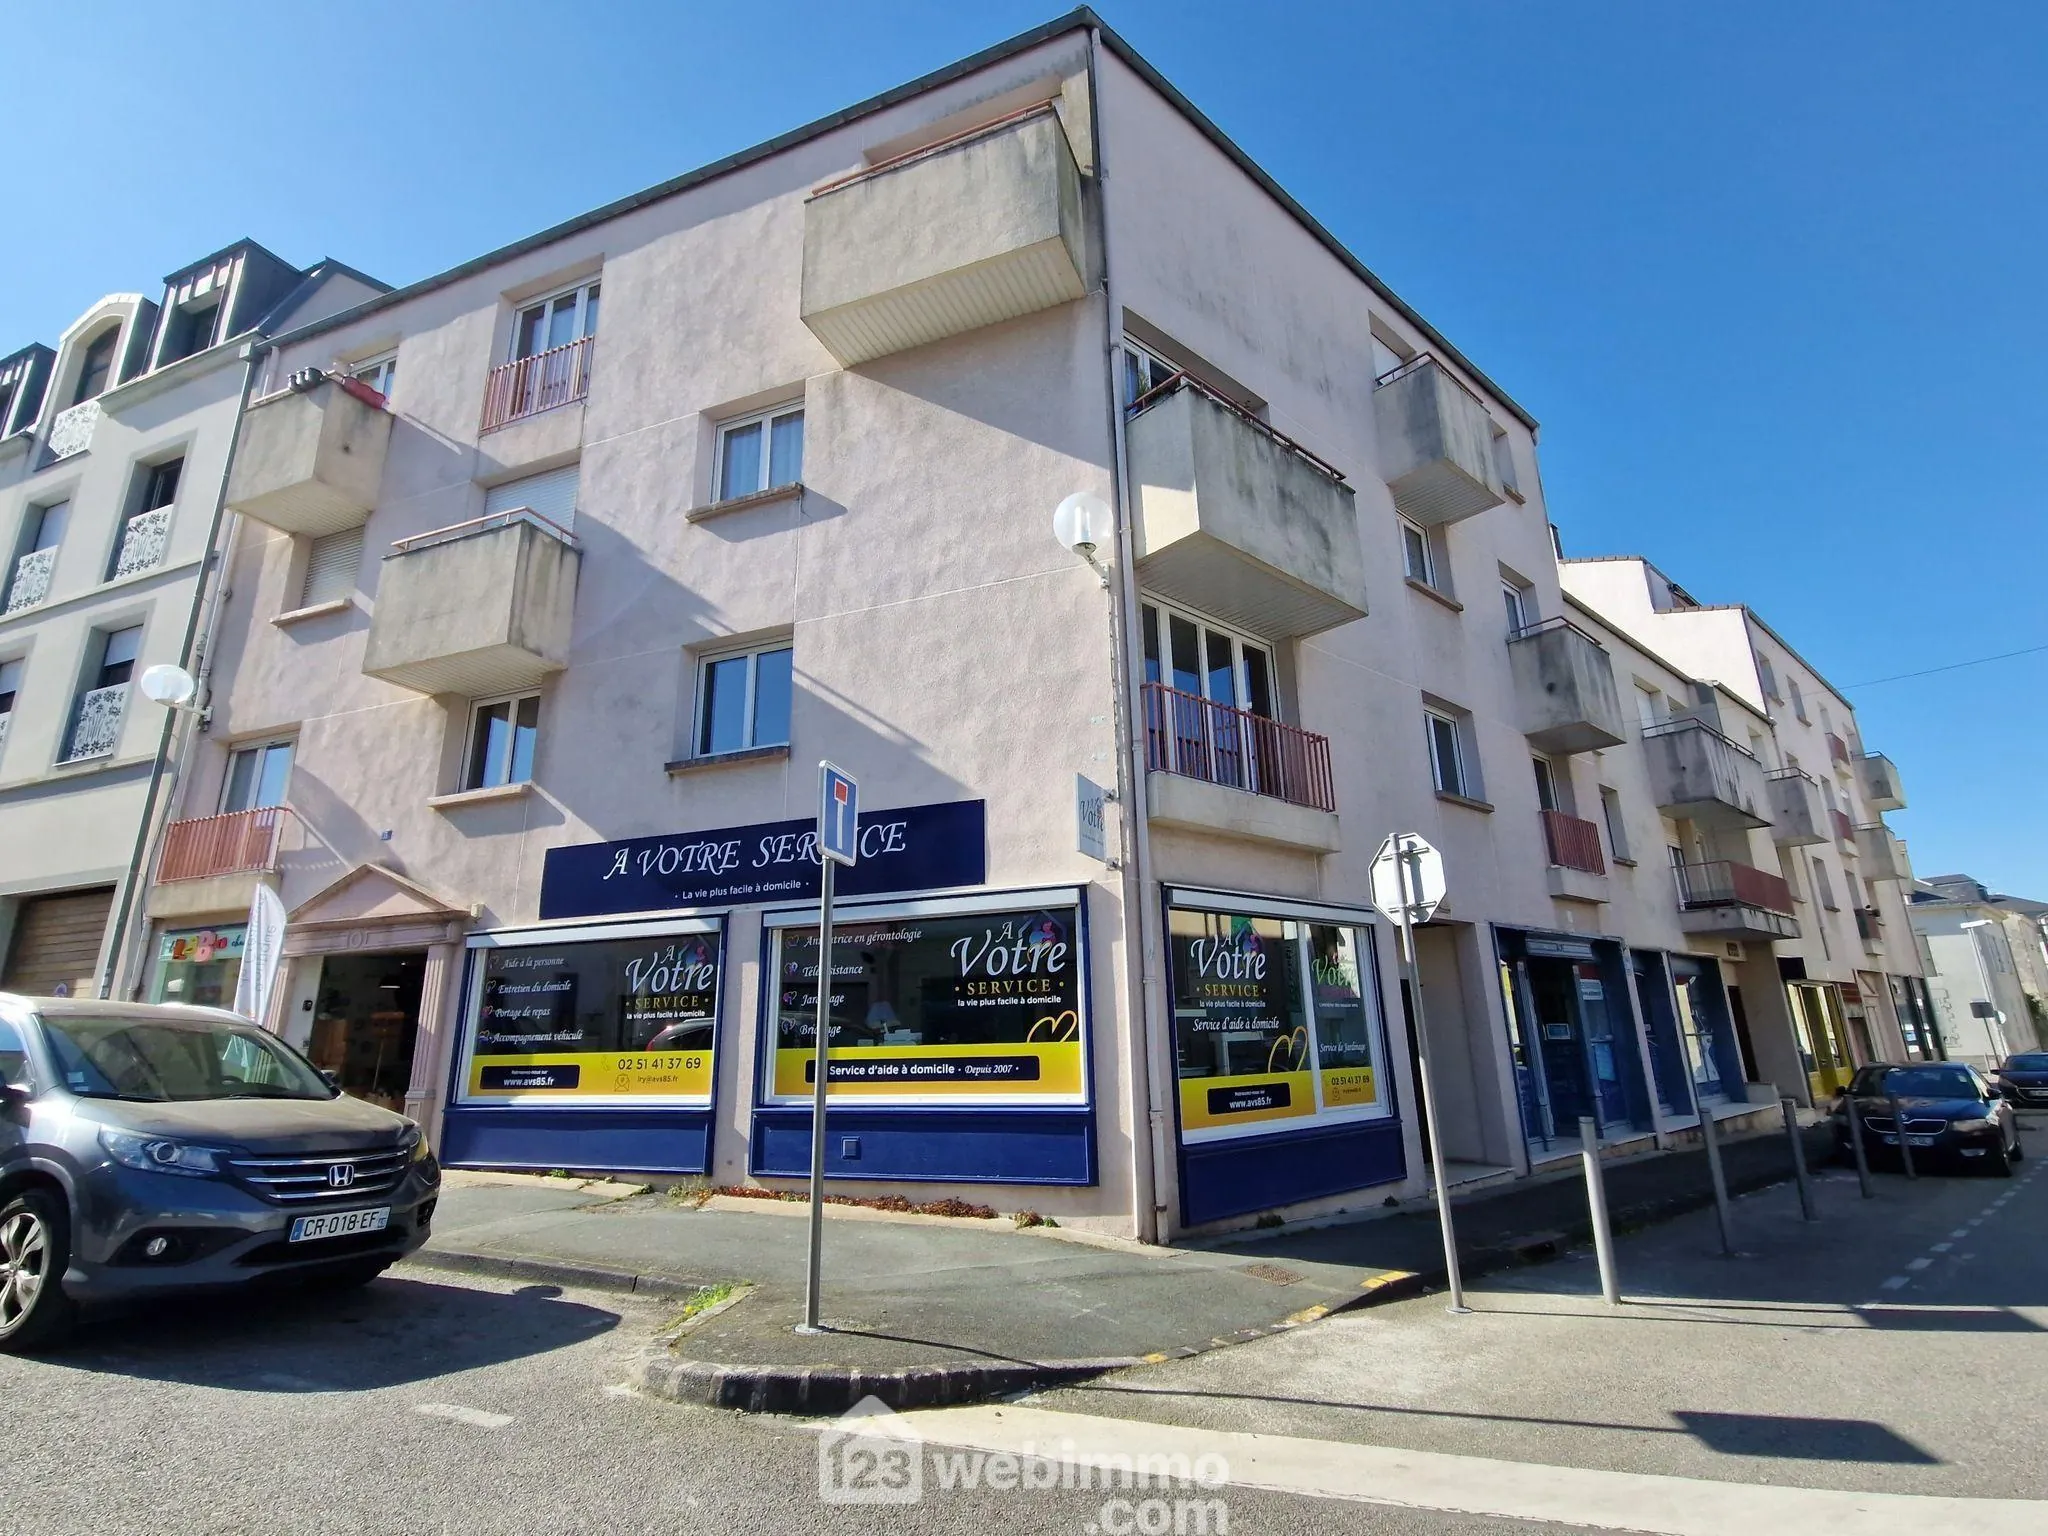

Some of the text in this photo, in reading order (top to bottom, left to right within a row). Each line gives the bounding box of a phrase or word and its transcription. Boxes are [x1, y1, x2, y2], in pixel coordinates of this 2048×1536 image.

[636, 839, 742, 878] VOTRE
[752, 821, 907, 868] SERCE
[682, 880, 801, 900] La vie plus facile à domicile
[855, 935, 865, 943] en
[866, 928, 922, 946] gérontologie
[950, 929, 1066, 978] Votre
[1190, 933, 1266, 980] Votre
[526, 956, 532, 967] la
[533, 958, 564, 970] personne
[625, 952, 714, 993] Votre
[498, 980, 571, 994] Entretien du domicile
[968, 980, 1050, 995] SERVICE
[1204, 984, 1260, 997] SERVICE
[635, 996, 699, 1009] SERVICE
[966, 998, 978, 1006] vie
[980, 998, 996, 1007] plus
[998, 997, 1018, 1005] facile
[1020, 996, 1025, 1004] à
[1027, 996, 1061, 1004] domicile
[495, 1006, 550, 1020] Portage de repas
[643, 1012, 656, 1020] plus
[679, 1010, 705, 1018] domicile
[1192, 1019, 1220, 1032] Service
[1245, 1019, 1250, 1030] à
[1252, 1016, 1280, 1029] domicile
[492, 1033, 552, 1044] Accompagnement
[618, 1057, 700, 1070] 02 51 41 37 69
[830, 1064, 1012, 1077] Service d'aide à domicile Depuis 2007
[504, 1076, 554, 1086] www.avs85.fr
[1332, 1077, 1339, 1086] 02
[1229, 1097, 1272, 1109] www.avs85.fr
[304, 1212, 379, 1236] CR-018-EF
